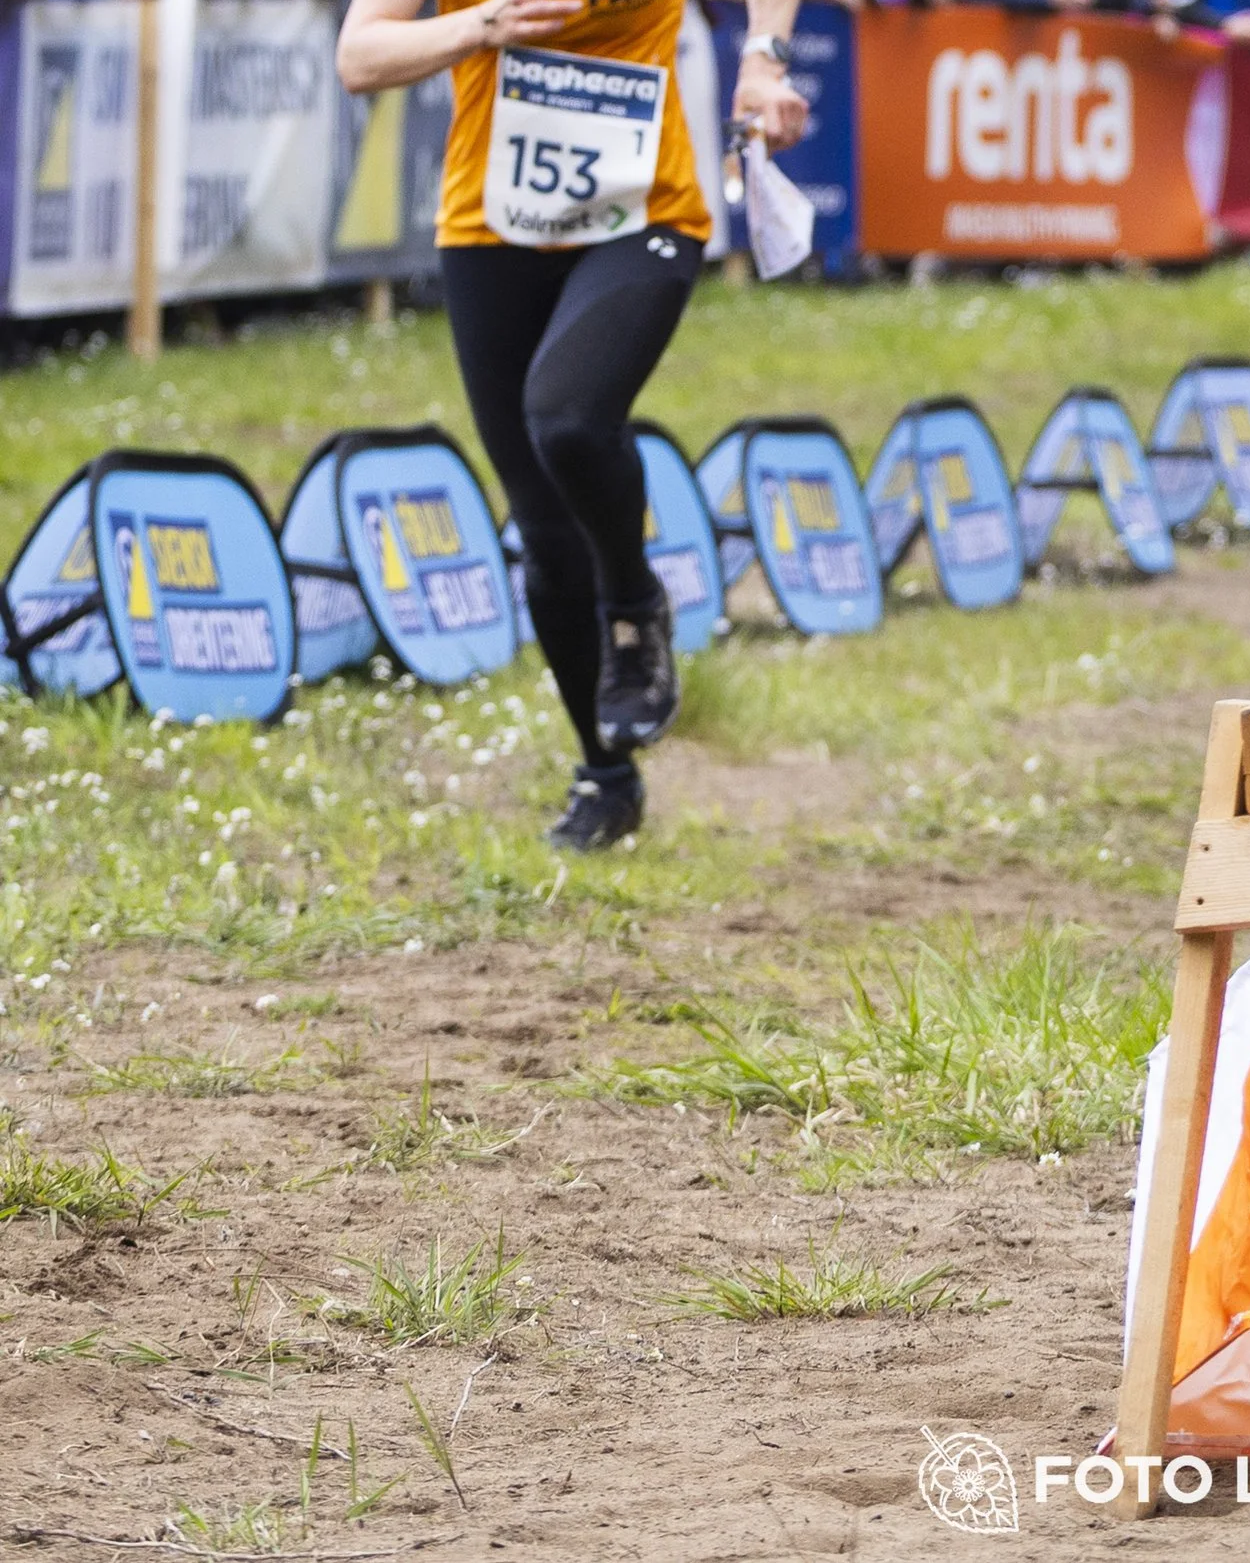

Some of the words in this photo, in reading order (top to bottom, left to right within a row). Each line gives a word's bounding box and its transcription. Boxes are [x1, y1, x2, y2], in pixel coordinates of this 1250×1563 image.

[504, 54, 658, 103] bagheera
[926, 30, 1132, 185] renta
[508, 135, 601, 202] 153
[634, 128, 645, 156] 1
